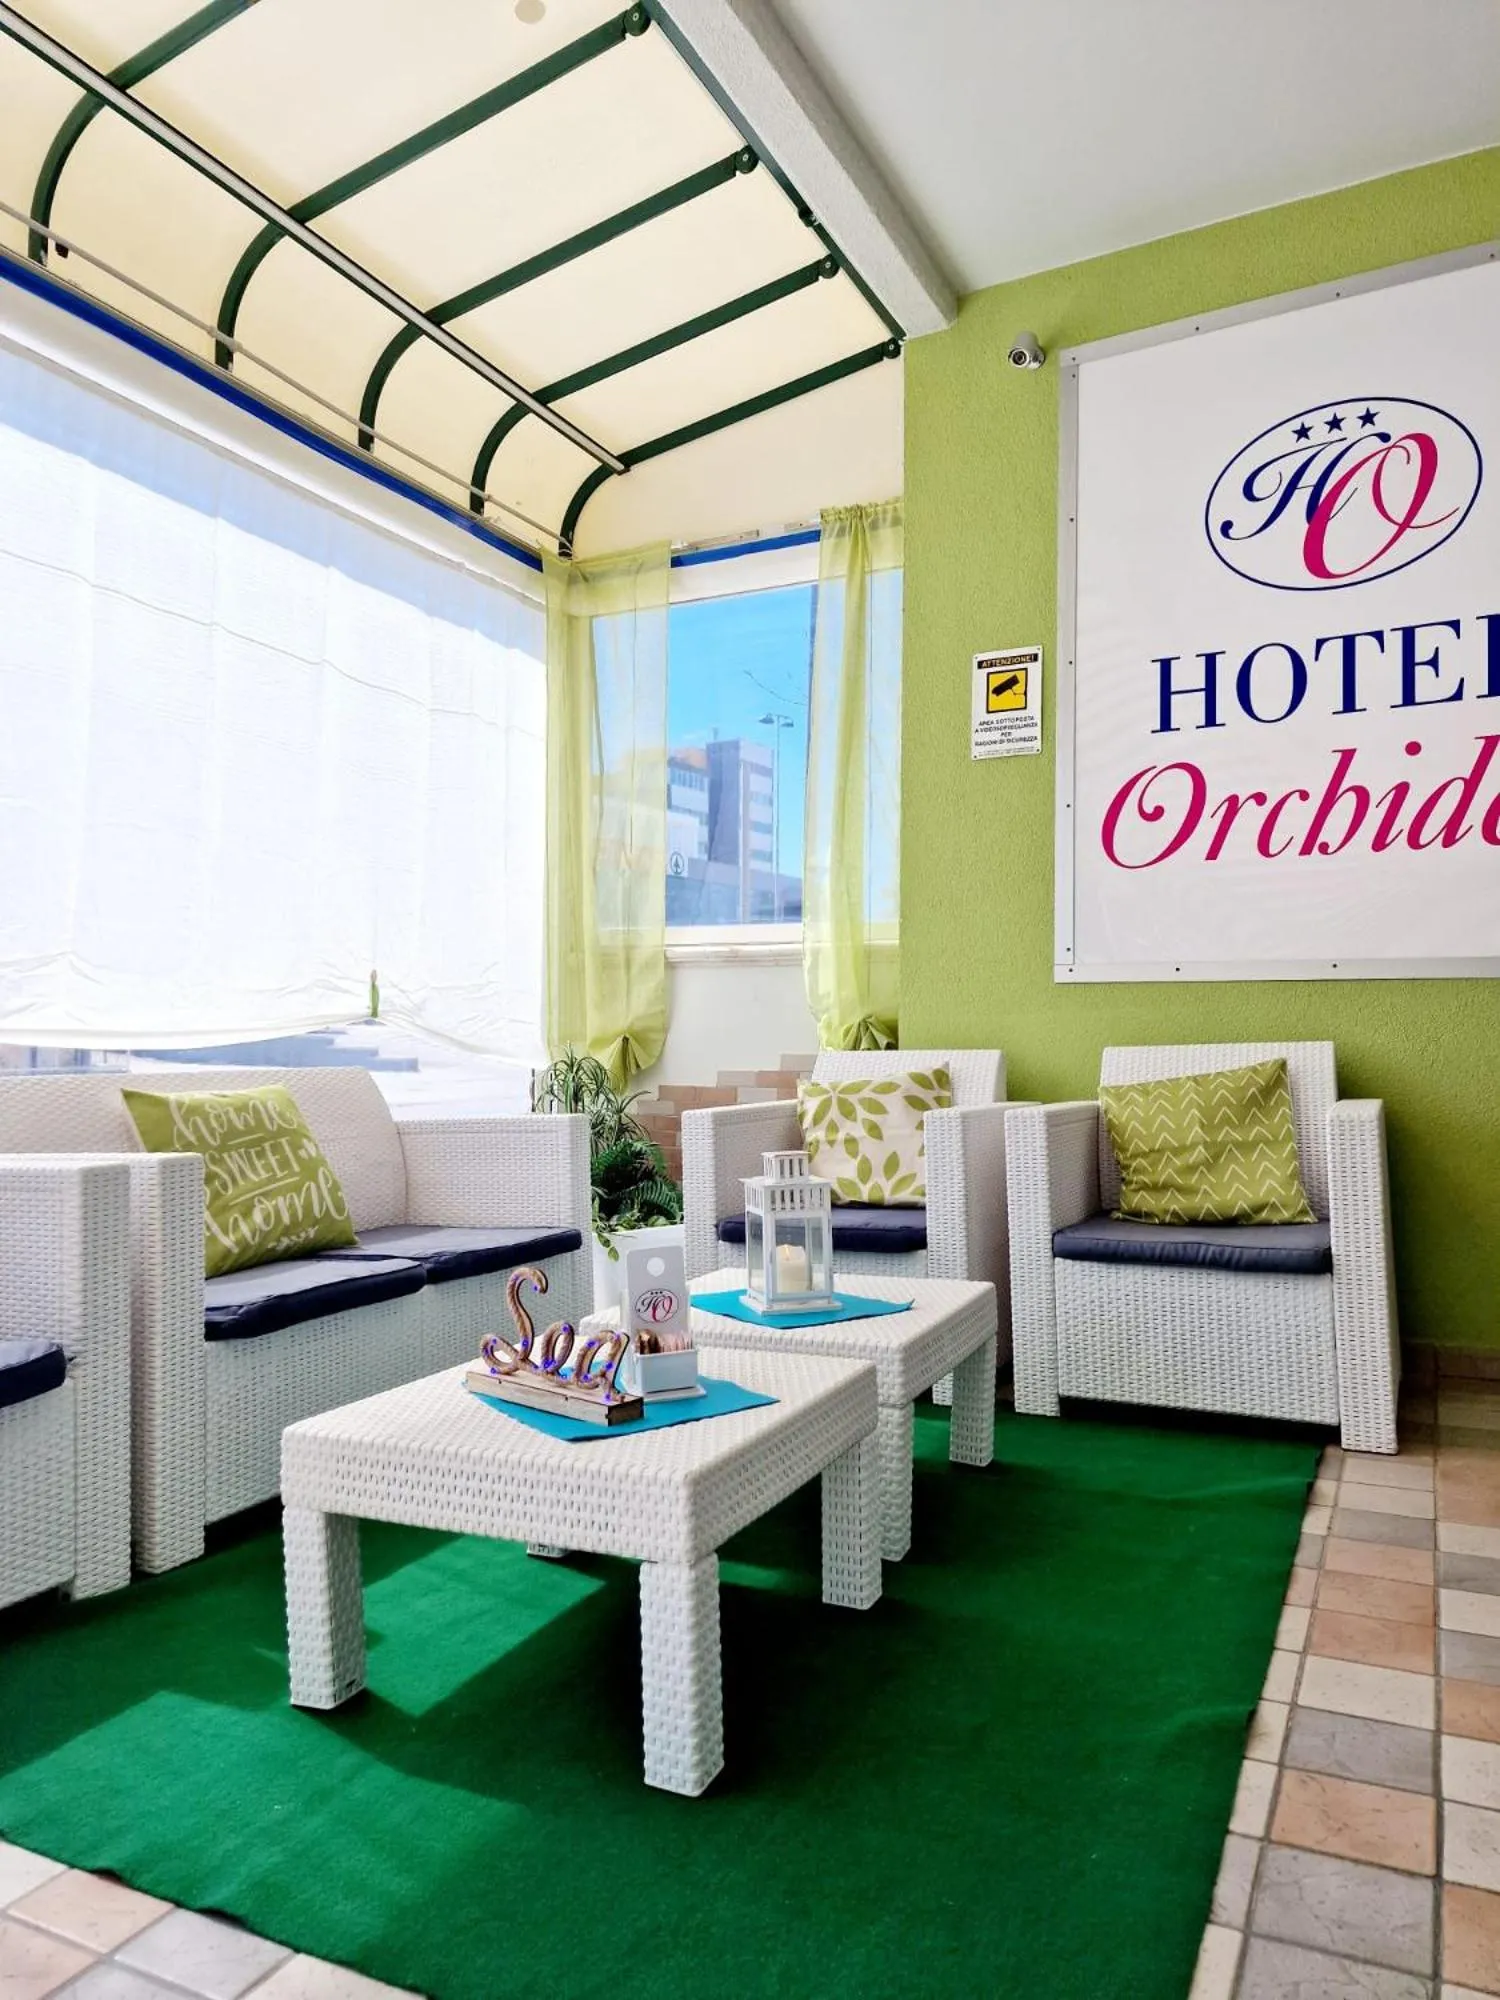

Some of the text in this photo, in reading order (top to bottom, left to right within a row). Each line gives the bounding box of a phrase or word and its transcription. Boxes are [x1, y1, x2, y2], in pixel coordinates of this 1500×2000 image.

[982, 654, 1034, 668] ATTENZIONE!
[169, 1096, 298, 1151] home
[205, 1136, 301, 1196] SWEET
